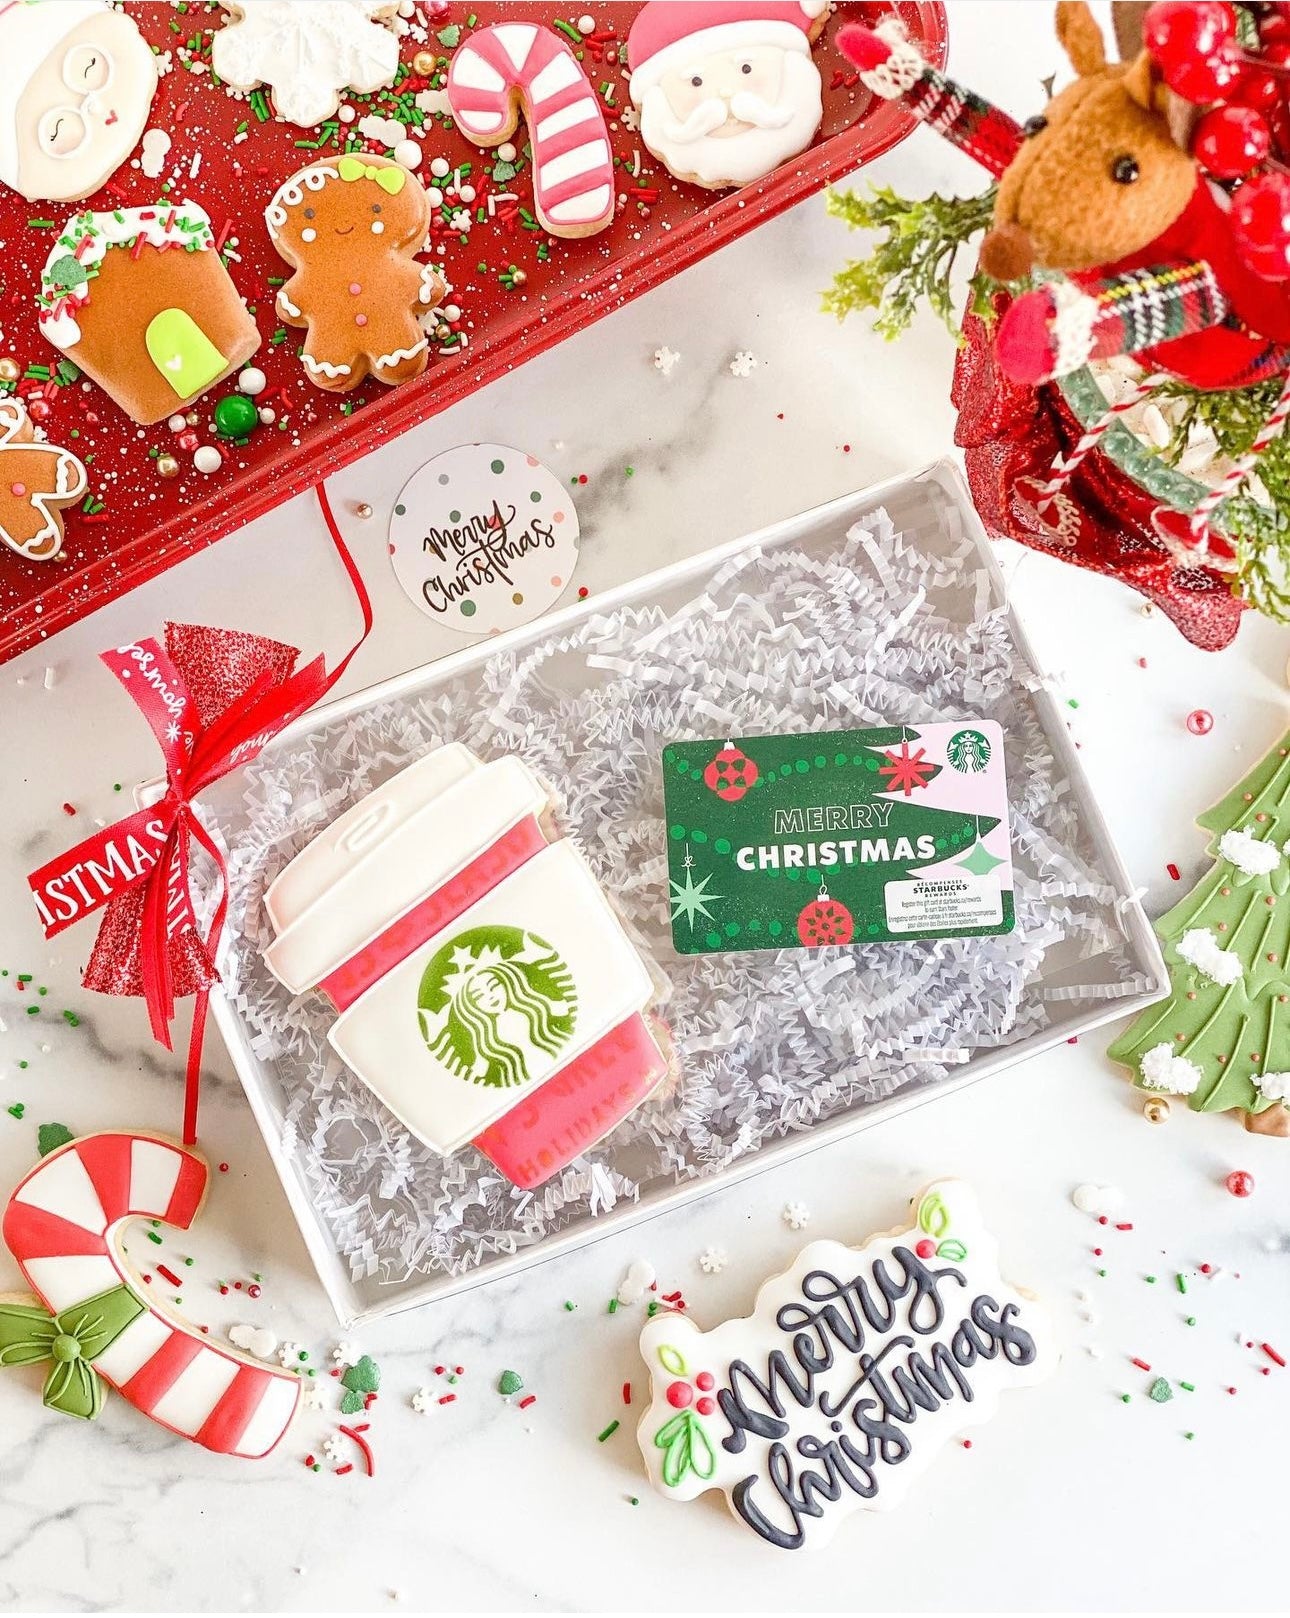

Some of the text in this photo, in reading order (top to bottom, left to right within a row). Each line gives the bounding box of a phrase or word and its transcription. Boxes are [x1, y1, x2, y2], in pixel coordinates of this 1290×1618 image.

[422, 518, 556, 613] Christmas
[423, 499, 516, 562] Merry
[736, 835, 936, 871] CHRISTMAS
[774, 802, 894, 834] MERRY
[717, 1245, 968, 1454] Merry
[732, 1293, 1038, 1550] Christmas
